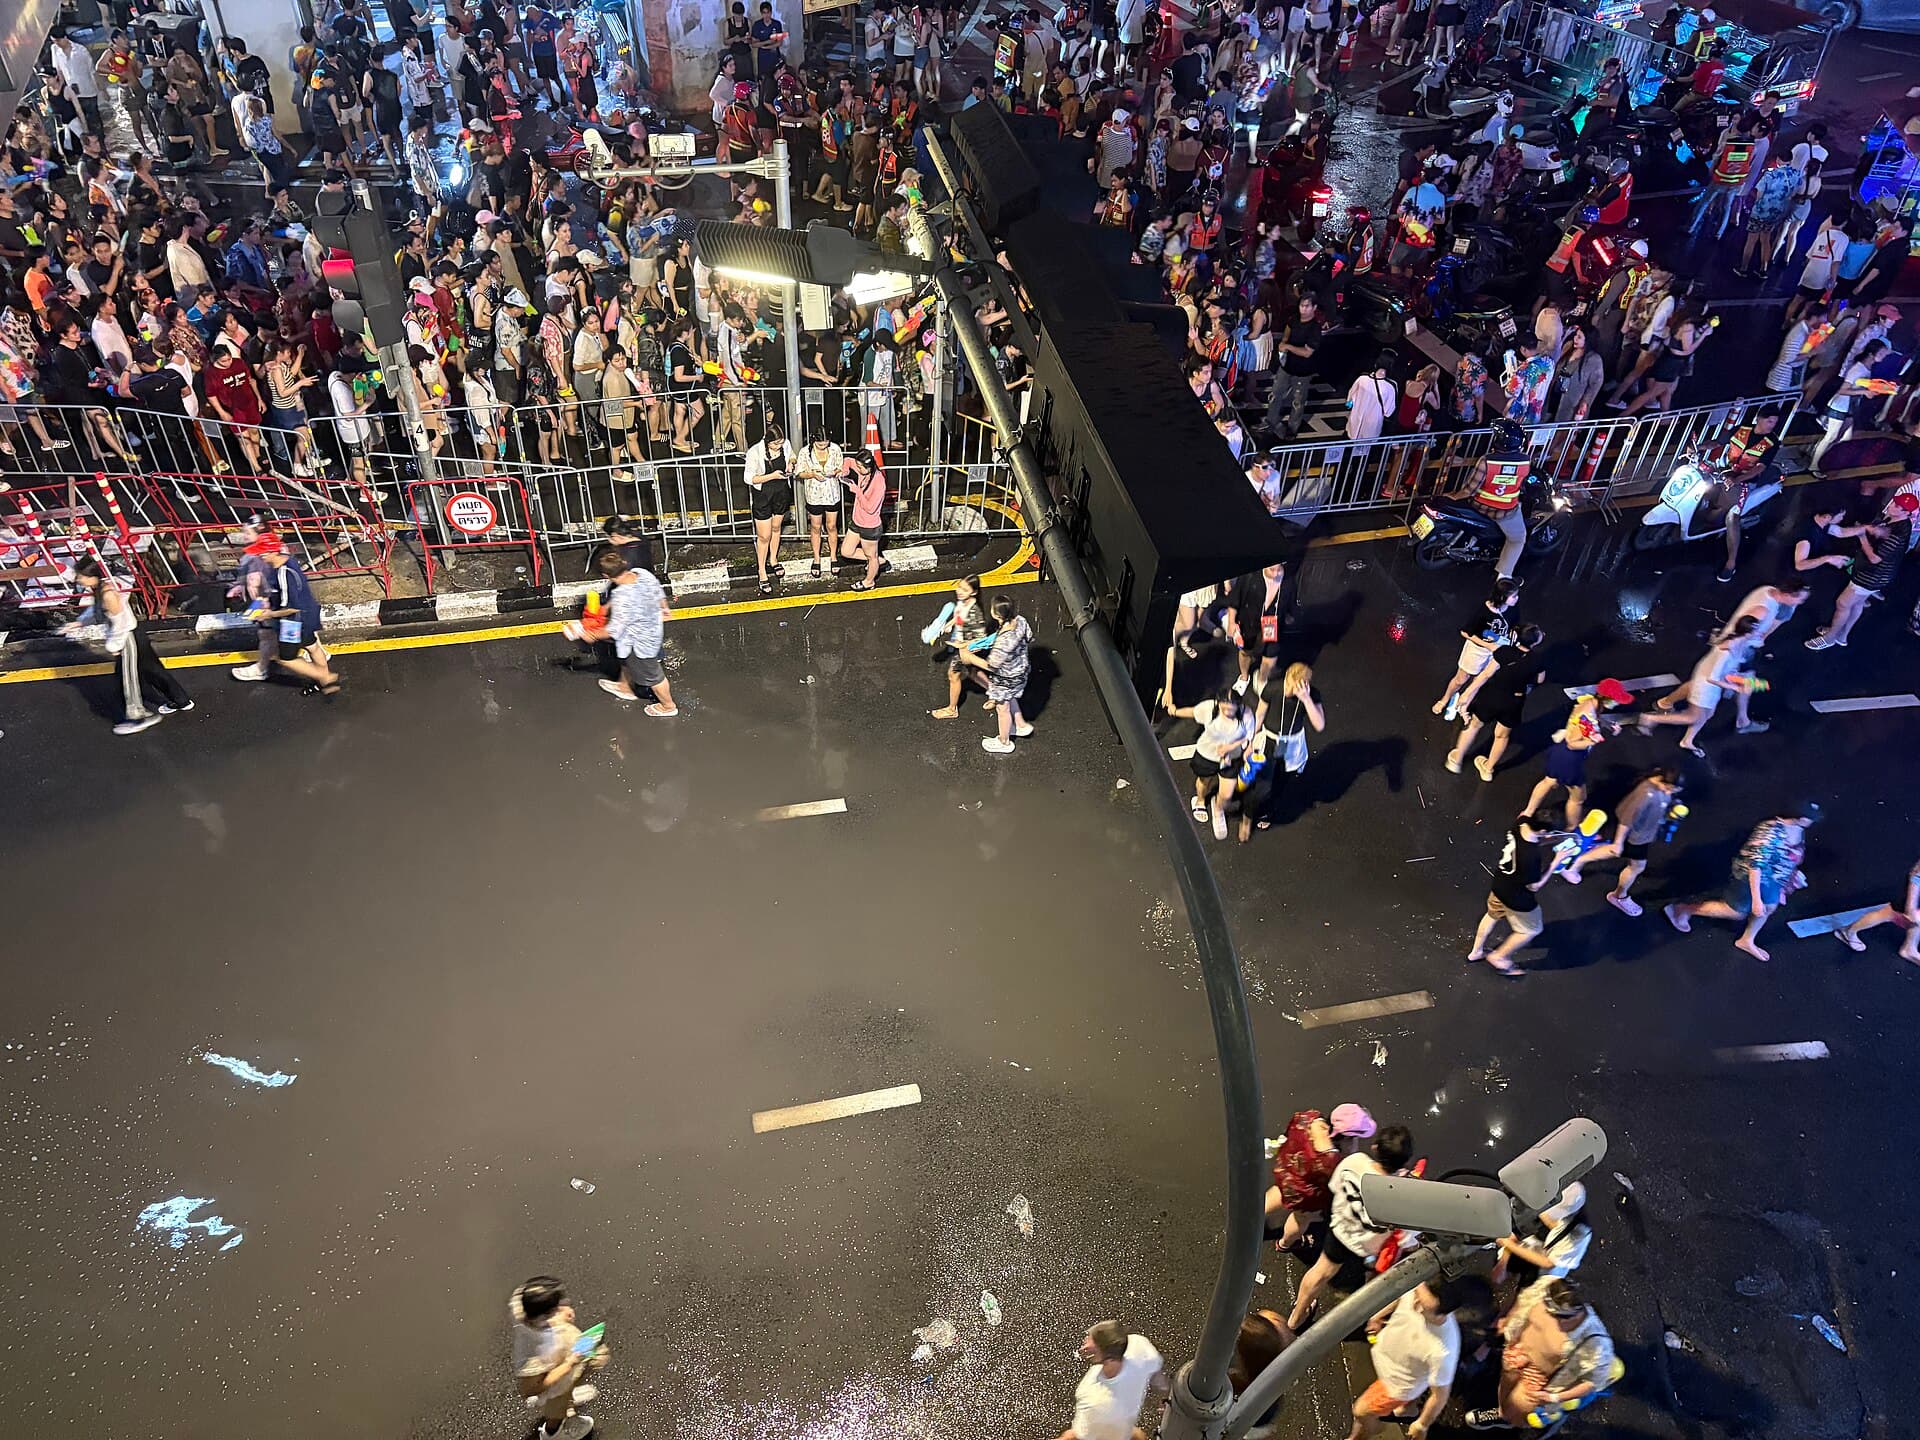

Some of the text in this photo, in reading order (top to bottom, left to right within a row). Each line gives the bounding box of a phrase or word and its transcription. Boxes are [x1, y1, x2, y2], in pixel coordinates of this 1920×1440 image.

[1495, 485, 1506, 496] 3
[456, 501, 483, 513] หยุด
[458, 516, 488, 525] ตรวจ
